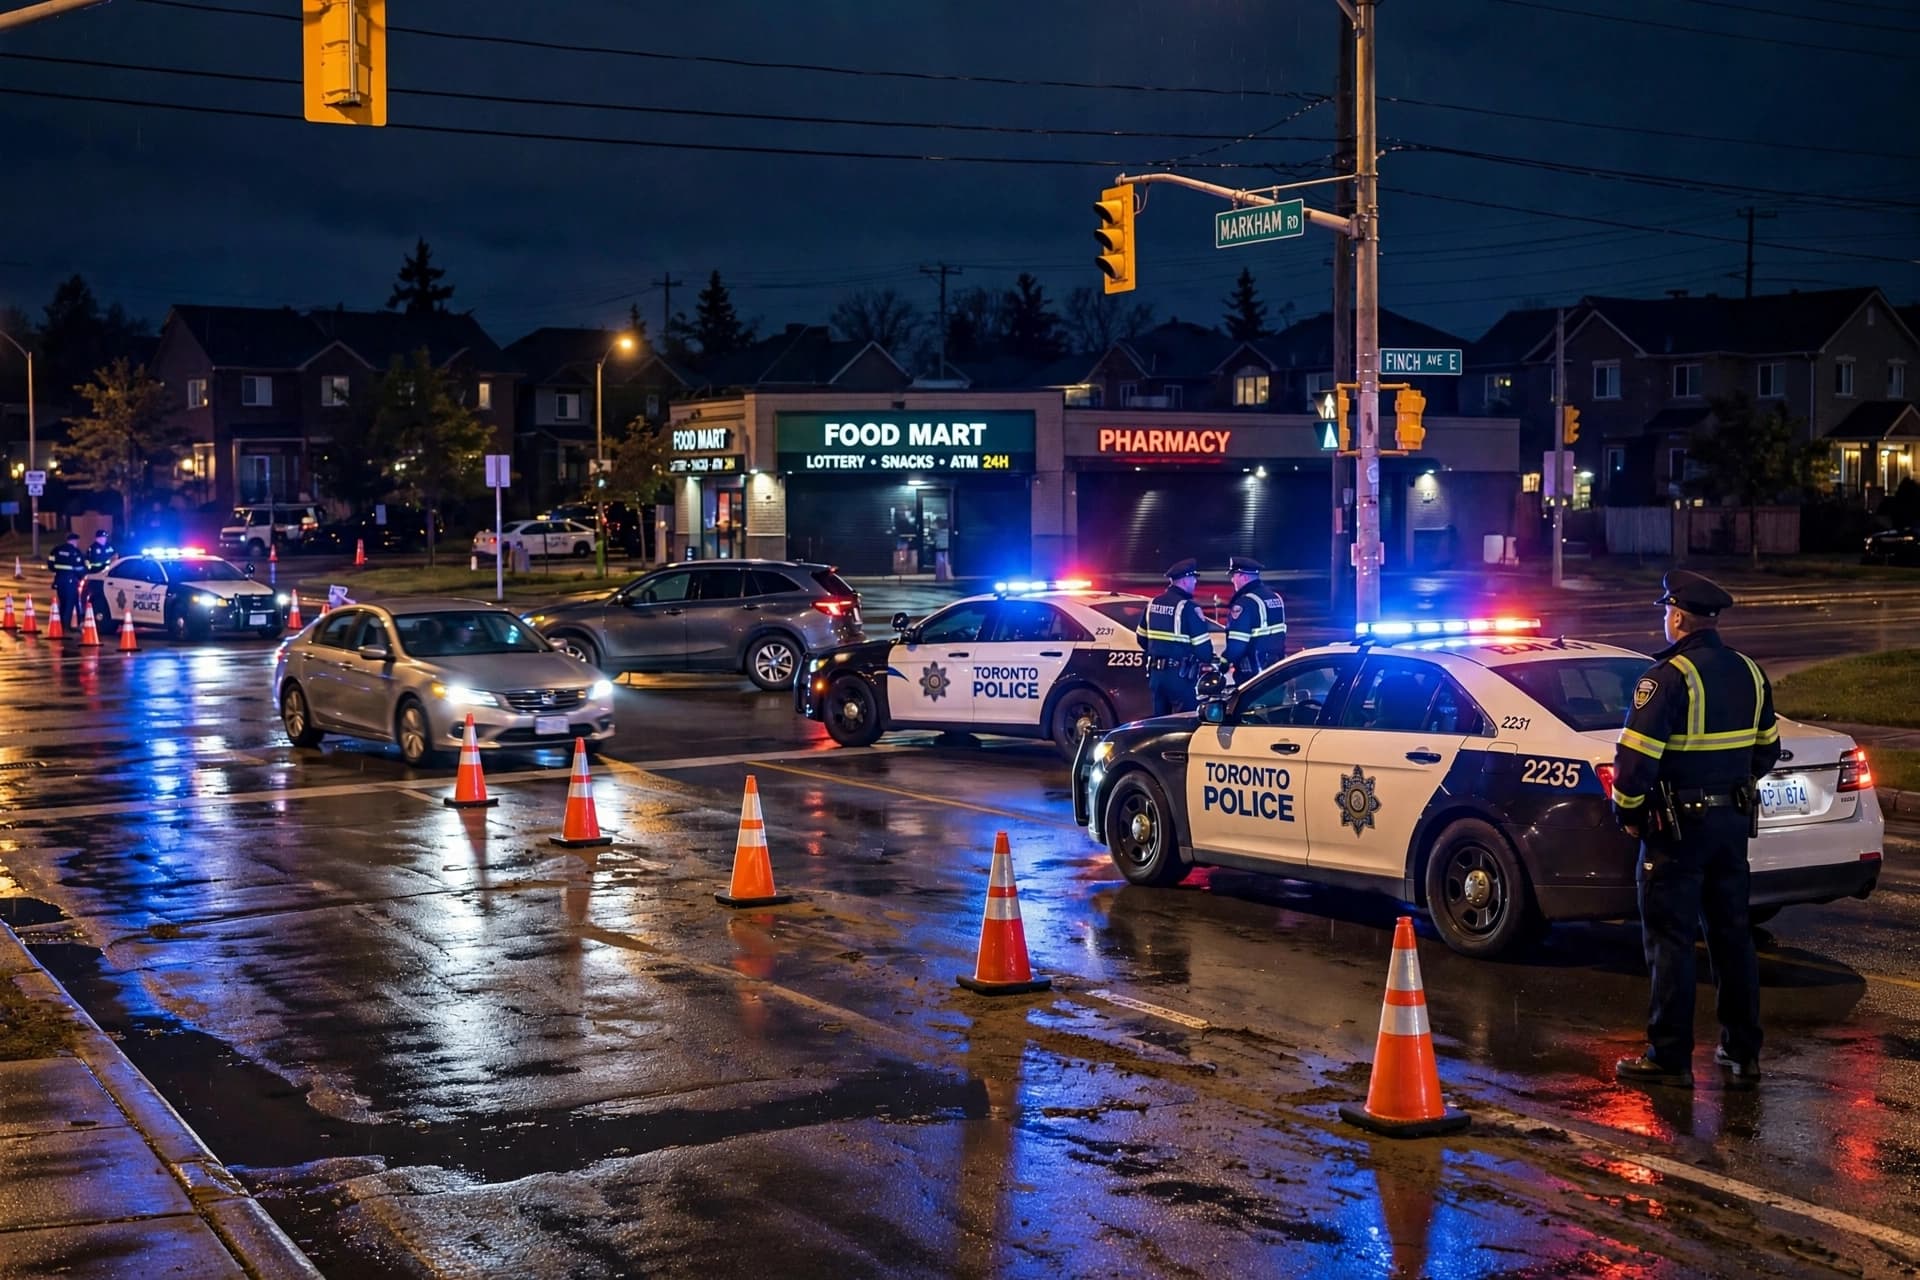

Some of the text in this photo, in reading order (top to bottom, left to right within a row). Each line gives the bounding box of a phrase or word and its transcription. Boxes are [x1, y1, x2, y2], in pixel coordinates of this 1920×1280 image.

[1221, 210, 1298, 240] MARKHAM RD
[1386, 353, 1456, 371] FINCH AVE E
[673, 428, 726, 451] FOOD MART
[824, 423, 986, 446] FOOD MART
[1100, 429, 1231, 453] PHARMACY
[806, 455, 1009, 469] LOTTERY SNACKS ATM 24H
[133, 600, 161, 612] POLICE
[1095, 627, 1114, 636] 2231
[1107, 652, 1144, 667] 2235
[973, 667, 1038, 680] TORONTO
[973, 681, 1039, 699] POLICE
[1501, 716, 1531, 731] 2231
[1205, 762, 1290, 790] TORONTO
[1521, 759, 1581, 788] 2235
[1204, 785, 1295, 823] POLICE
